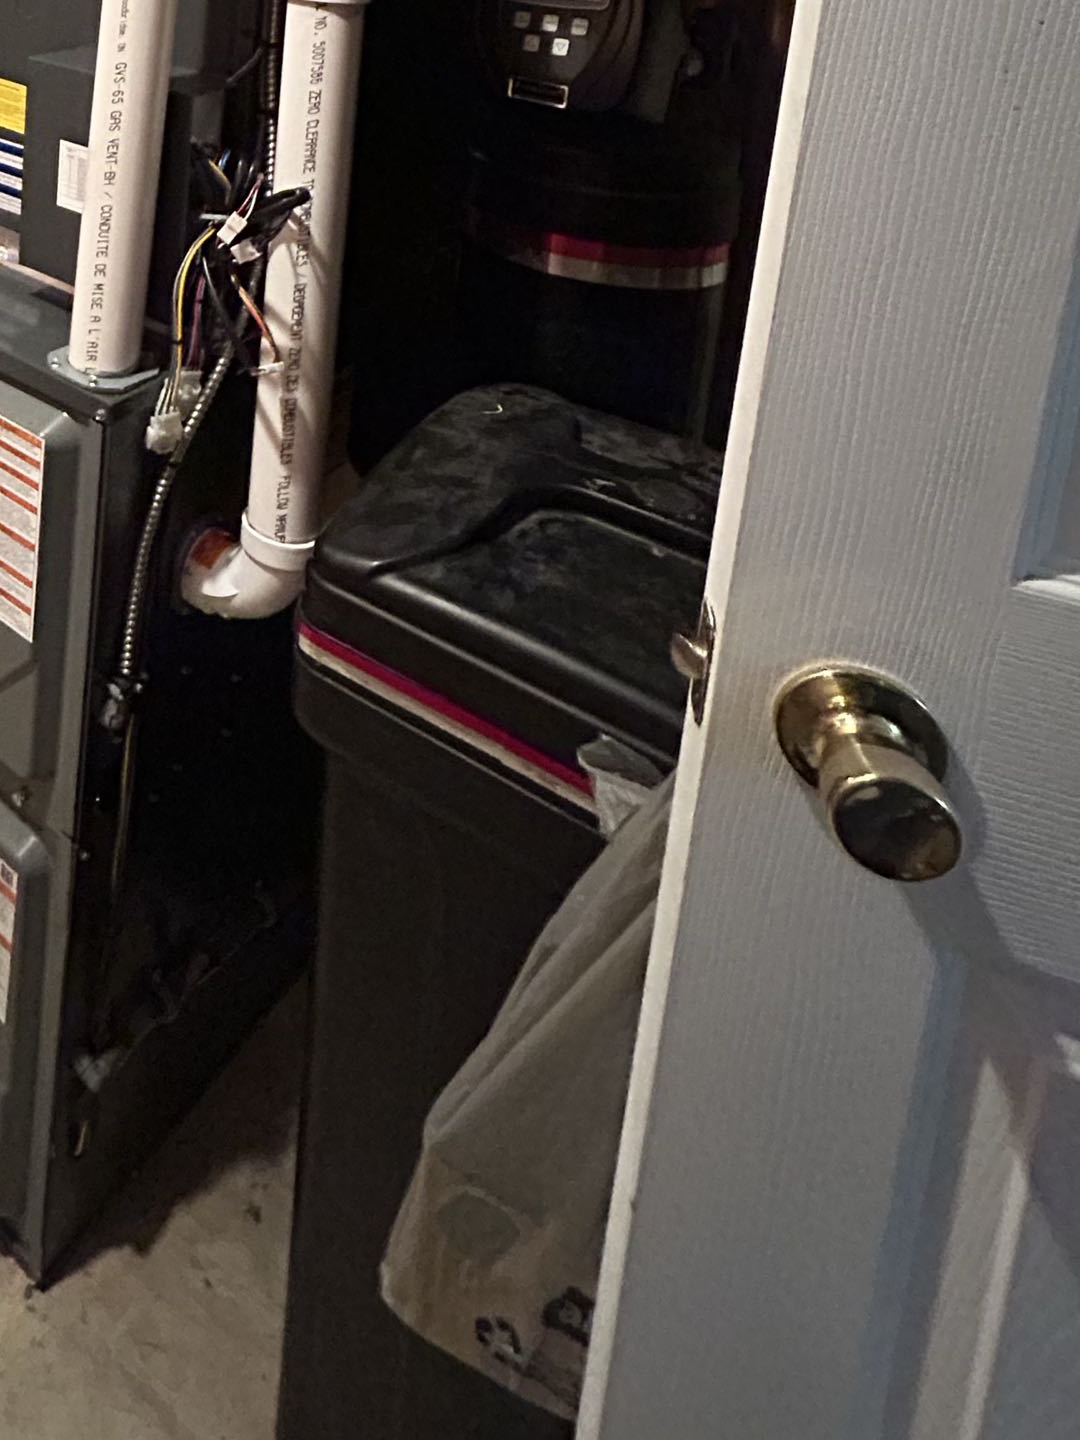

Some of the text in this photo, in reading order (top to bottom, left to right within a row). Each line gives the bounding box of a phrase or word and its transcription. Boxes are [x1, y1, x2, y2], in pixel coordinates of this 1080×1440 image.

[111, 61, 128, 105] GVS-65
[307, 89, 322, 115] ZERO
[108, 111, 123, 132] GAS
[303, 119, 320, 174] CLEARANCE
[95, 206, 113, 258] CONDUITE
[93, 262, 107, 278] DE
[89, 283, 105, 310] MISE
[86, 327, 101, 362] L'AIR
[280, 398, 298, 465] COMBUSTIBLES
[276, 474, 292, 510] FOLLOW
